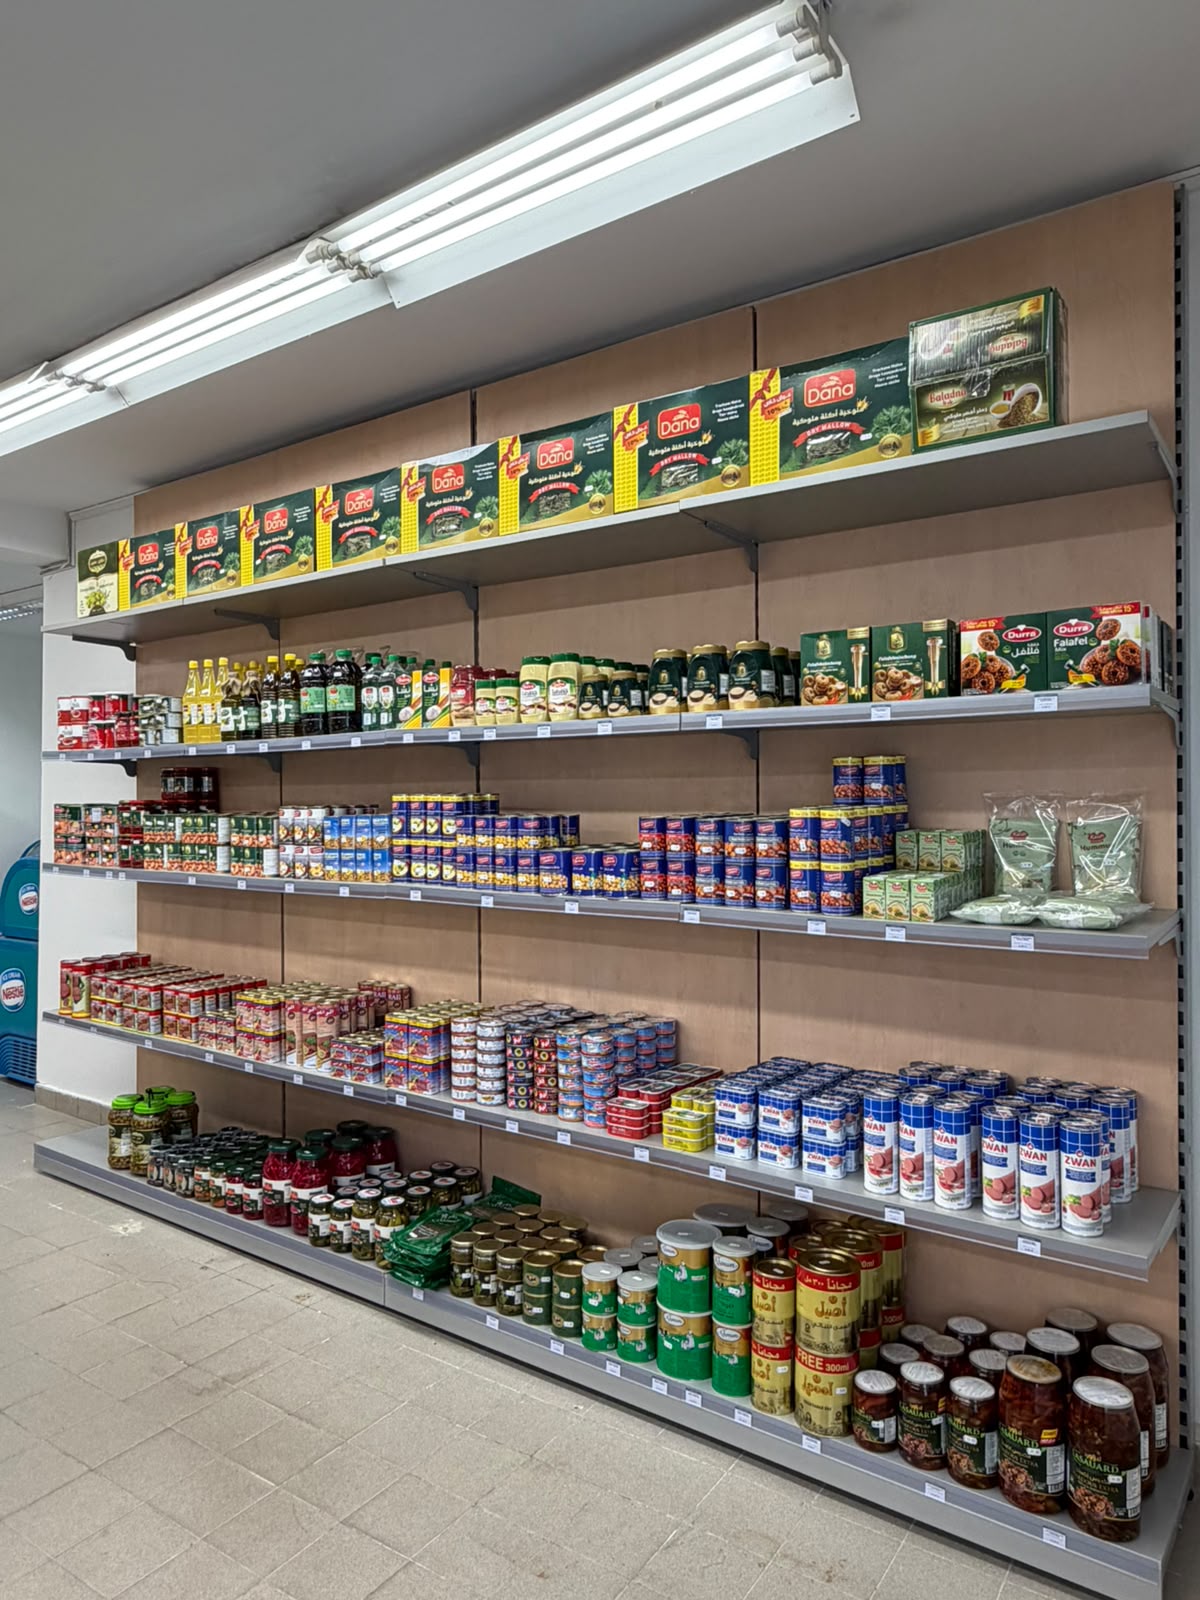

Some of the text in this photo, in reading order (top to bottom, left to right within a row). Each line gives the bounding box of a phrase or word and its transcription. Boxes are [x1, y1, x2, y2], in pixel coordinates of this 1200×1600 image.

[808, 383, 854, 404] Dana
[660, 417, 700, 436] Dana
[821, 422, 850, 432] MALLOW
[540, 449, 574, 466] Dana
[434, 476, 464, 490] Dana
[346, 499, 372, 512] Dana
[266, 518, 288, 530] Dana
[198, 536, 218, 546] Dana
[1008, 631, 1036, 639] Durra
[1058, 625, 1090, 633] Durra
[1053, 637, 1088, 647] Falafel
[1020, 1147, 1048, 1160] ZWAN
[1064, 1155, 1096, 1167] ZWAN
[797, 1349, 850, 1372] FREE 300ml
